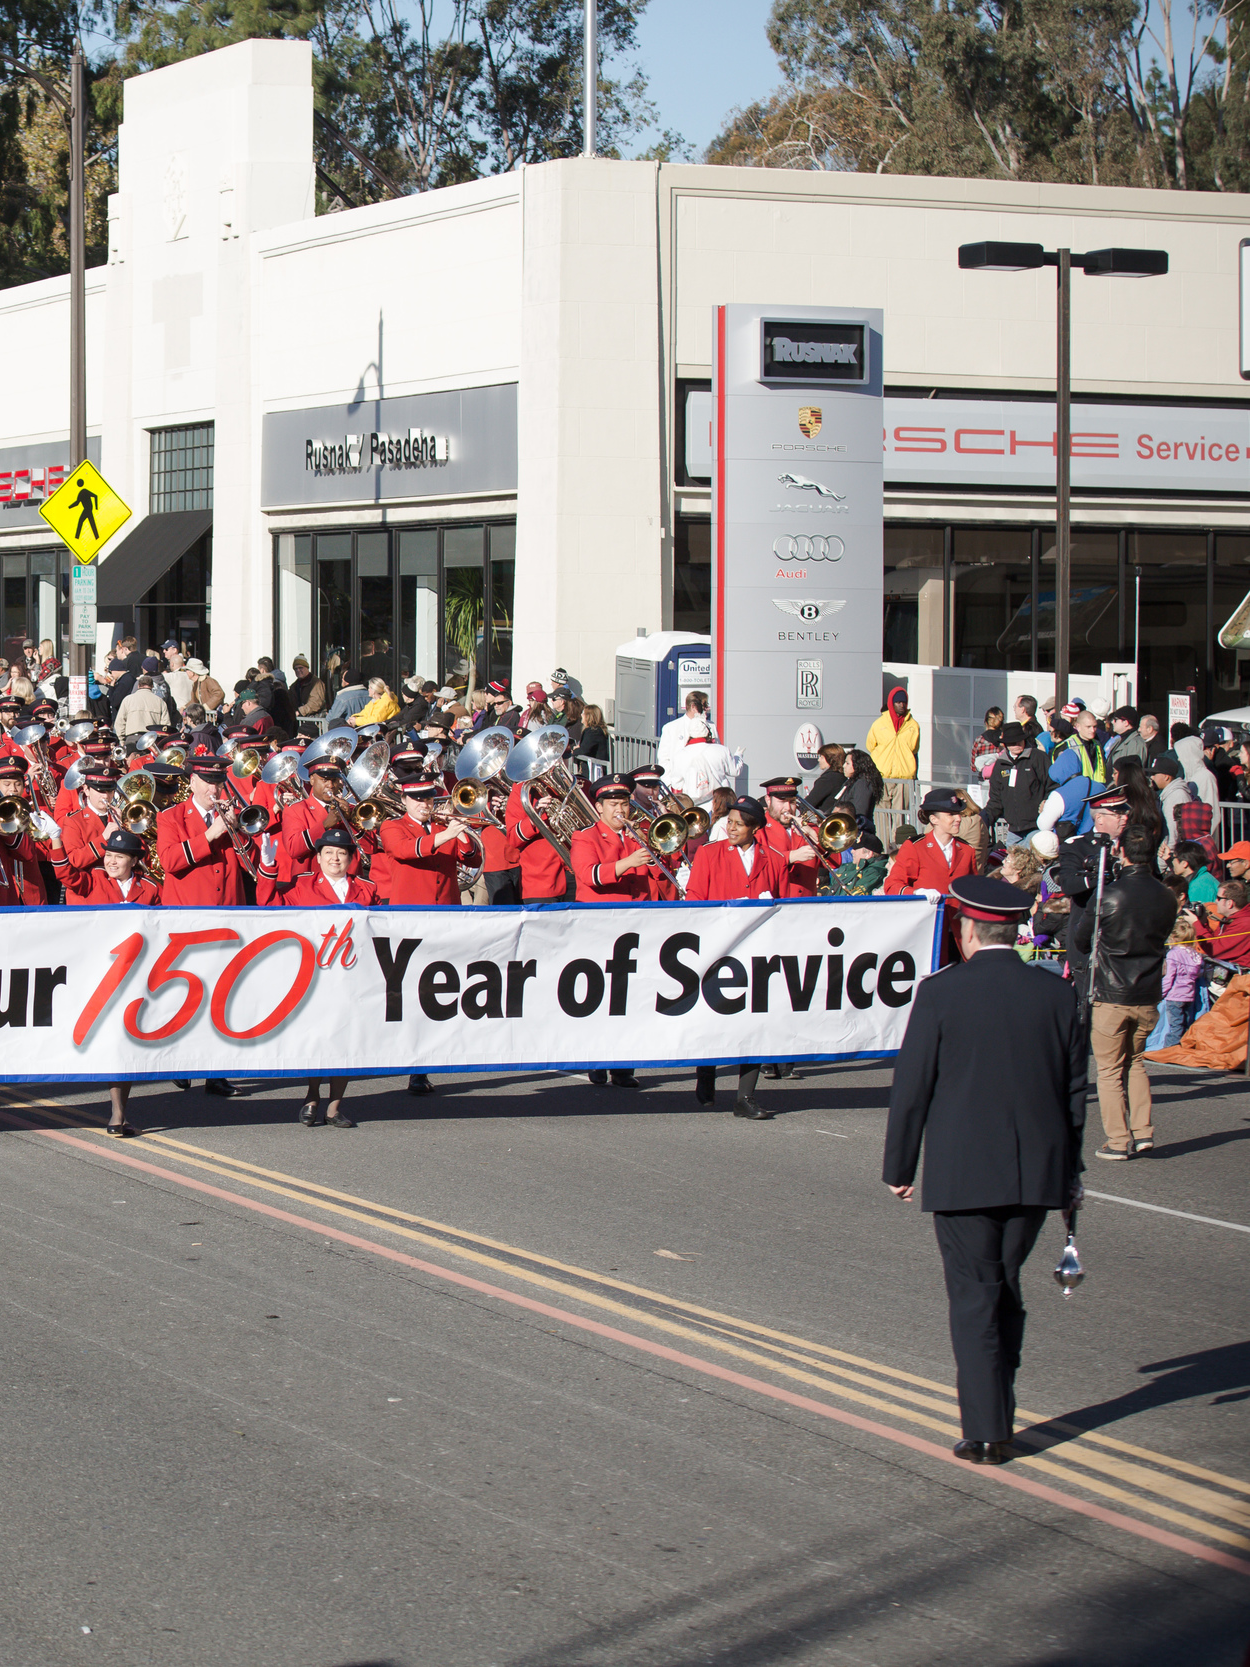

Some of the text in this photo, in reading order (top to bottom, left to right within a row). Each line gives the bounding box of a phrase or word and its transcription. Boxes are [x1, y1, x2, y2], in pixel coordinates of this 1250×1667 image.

[772, 337, 858, 364] RUSNAK
[306, 434, 352, 471] Rusnak
[370, 427, 437, 465] Pasadena
[771, 444, 847, 452] PORSCHE
[1136, 434, 1240, 462] Service
[768, 503, 849, 514] JAGUAR
[775, 568, 807, 579] Audi
[778, 631, 839, 641] BENTLEY
[682, 663, 711, 672] United
[372, 937, 536, 1023] Year
[557, 931, 638, 1020] of
[654, 926, 916, 1016] Service
